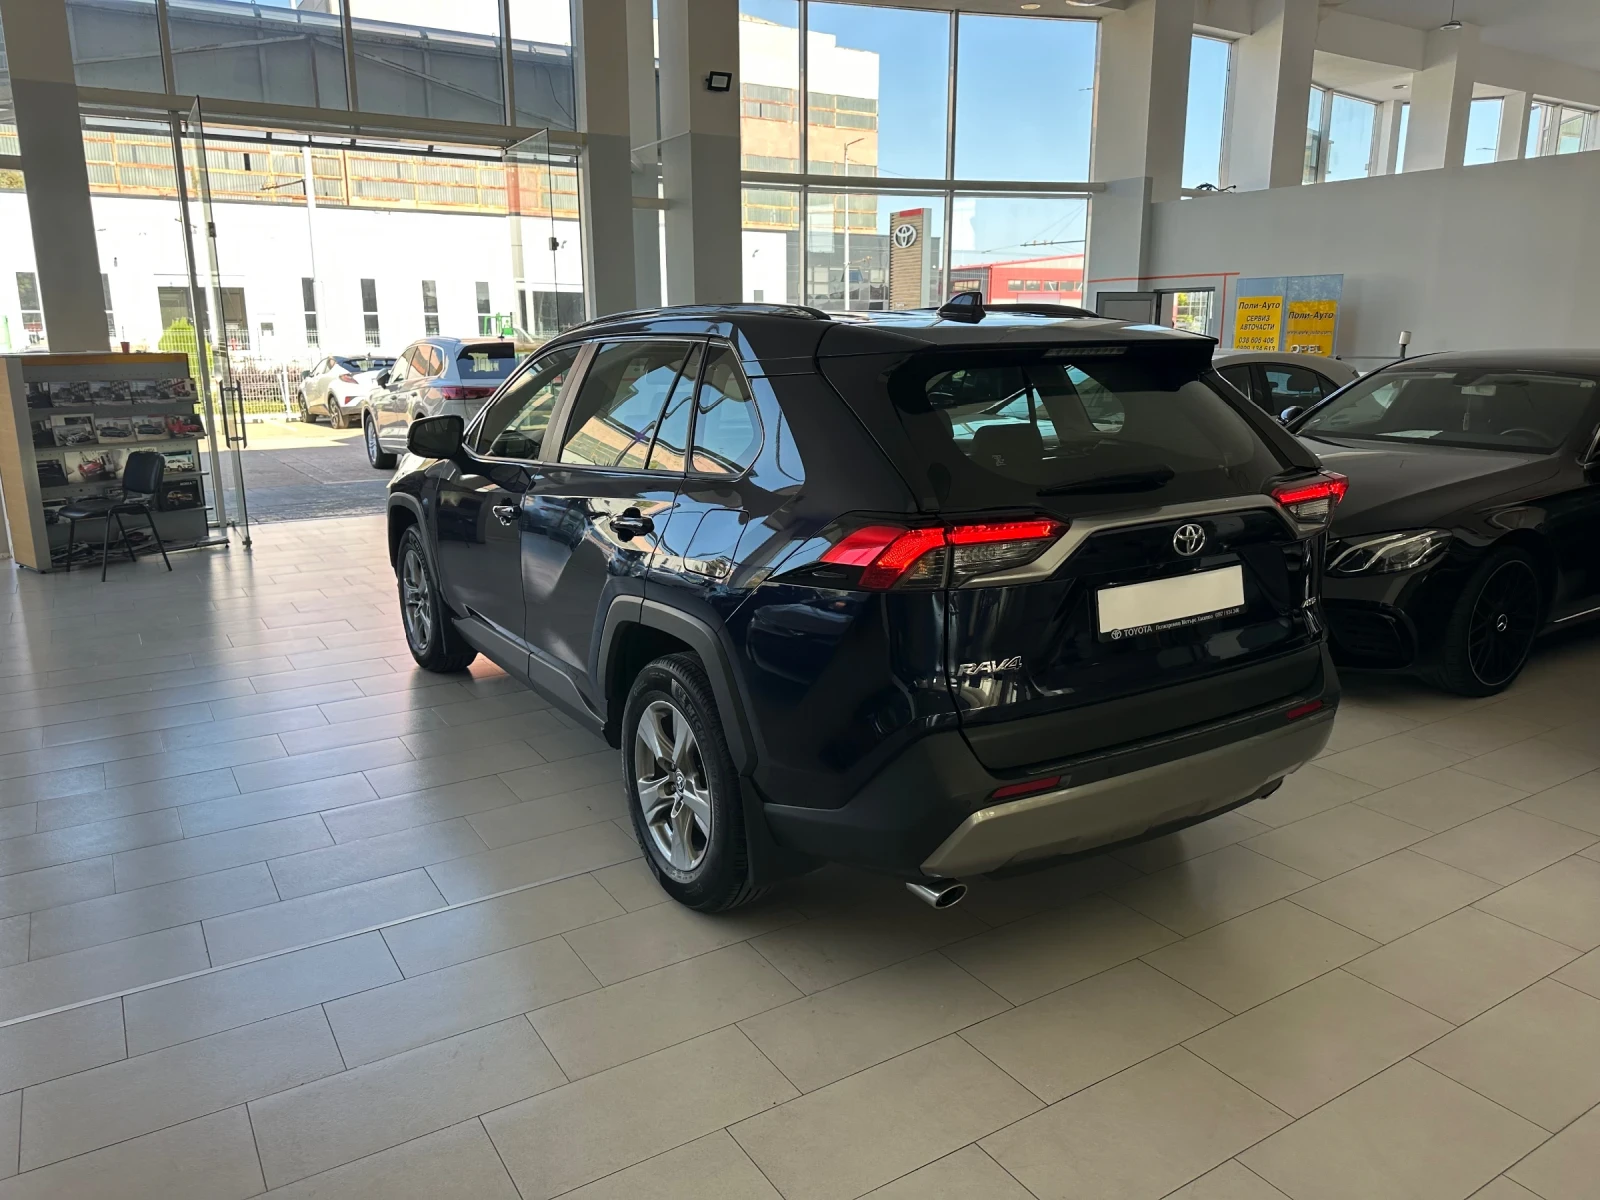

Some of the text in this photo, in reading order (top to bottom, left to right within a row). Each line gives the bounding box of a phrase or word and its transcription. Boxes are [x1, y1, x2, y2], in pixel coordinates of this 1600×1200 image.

[1239, 301, 1280, 311] Поли-Ауто
[1288, 311, 1334, 320] Поли-Ауто
[1240, 323, 1275, 331] АВТОЧАСТИ
[1291, 344, 1324, 354] OPEL
[1124, 625, 1153, 637] TOYOTA
[957, 655, 1023, 676] RAV4
